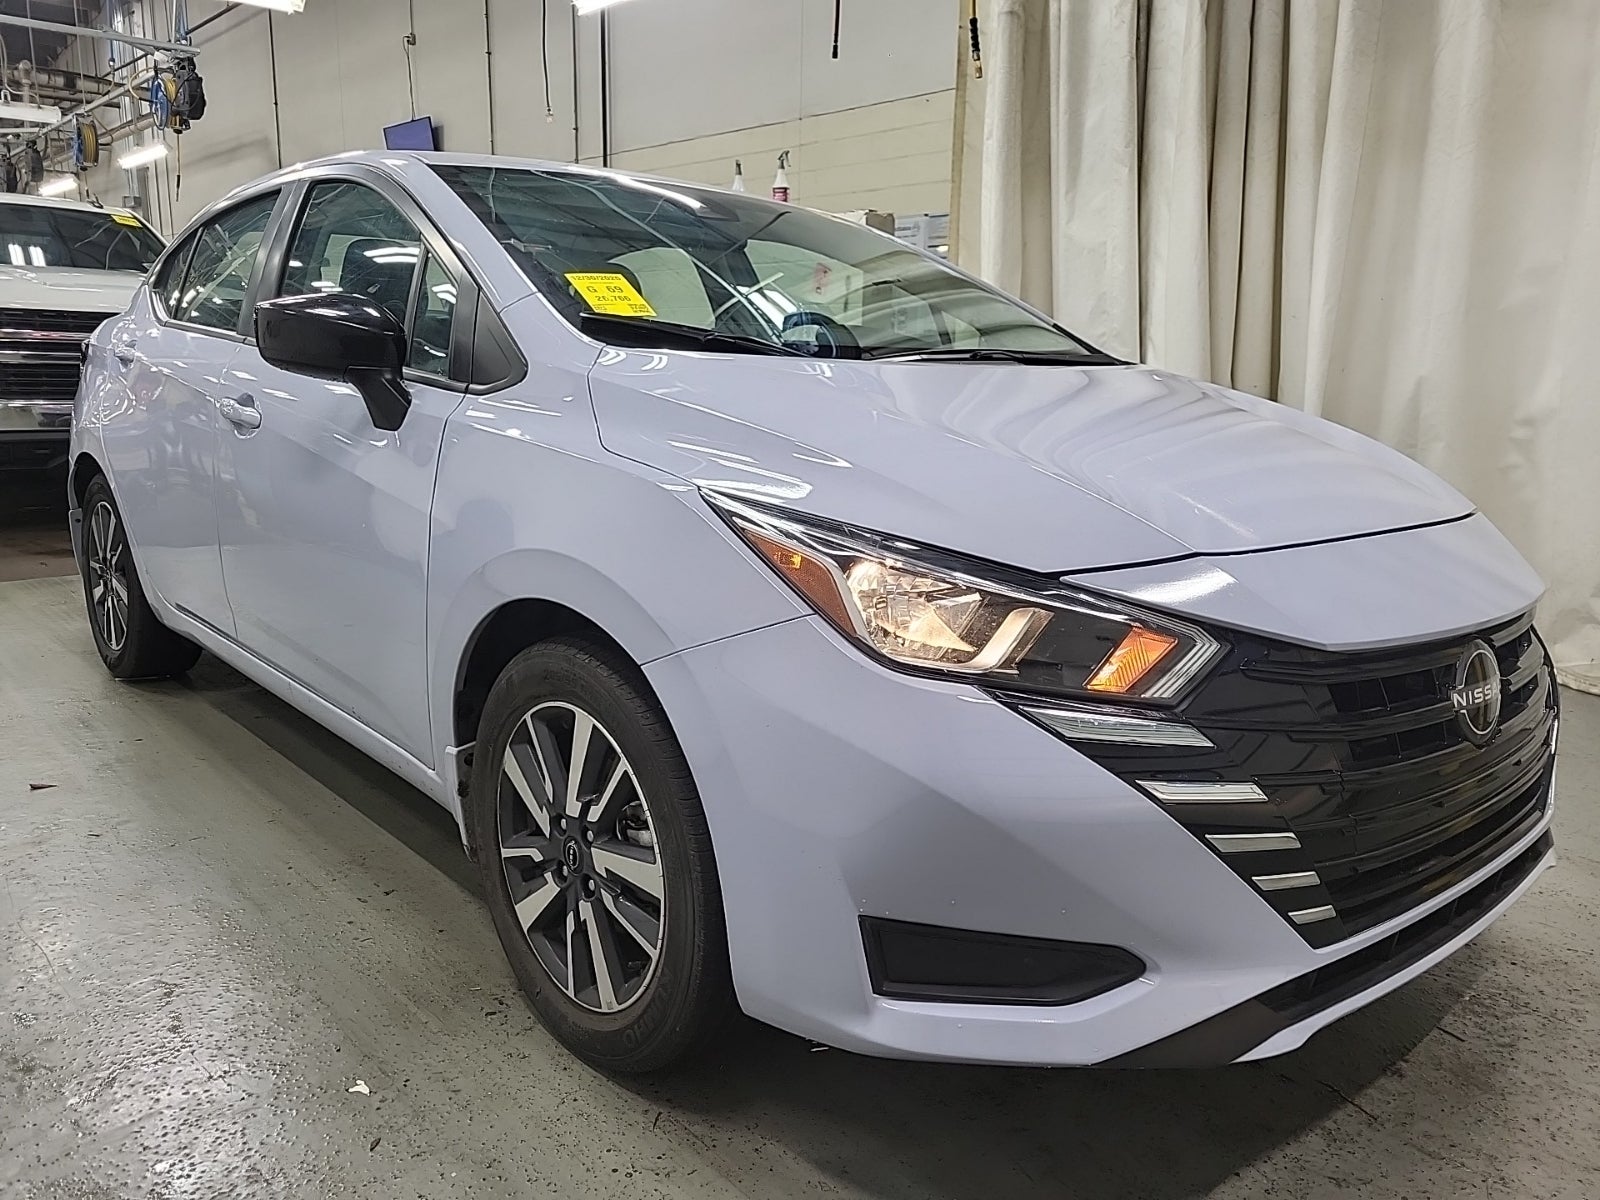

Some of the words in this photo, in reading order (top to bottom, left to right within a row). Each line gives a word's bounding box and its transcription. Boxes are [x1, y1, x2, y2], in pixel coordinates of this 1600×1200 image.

[586, 285, 598, 293] G
[605, 285, 624, 293] 69
[1452, 682, 1499, 708] NISSA
